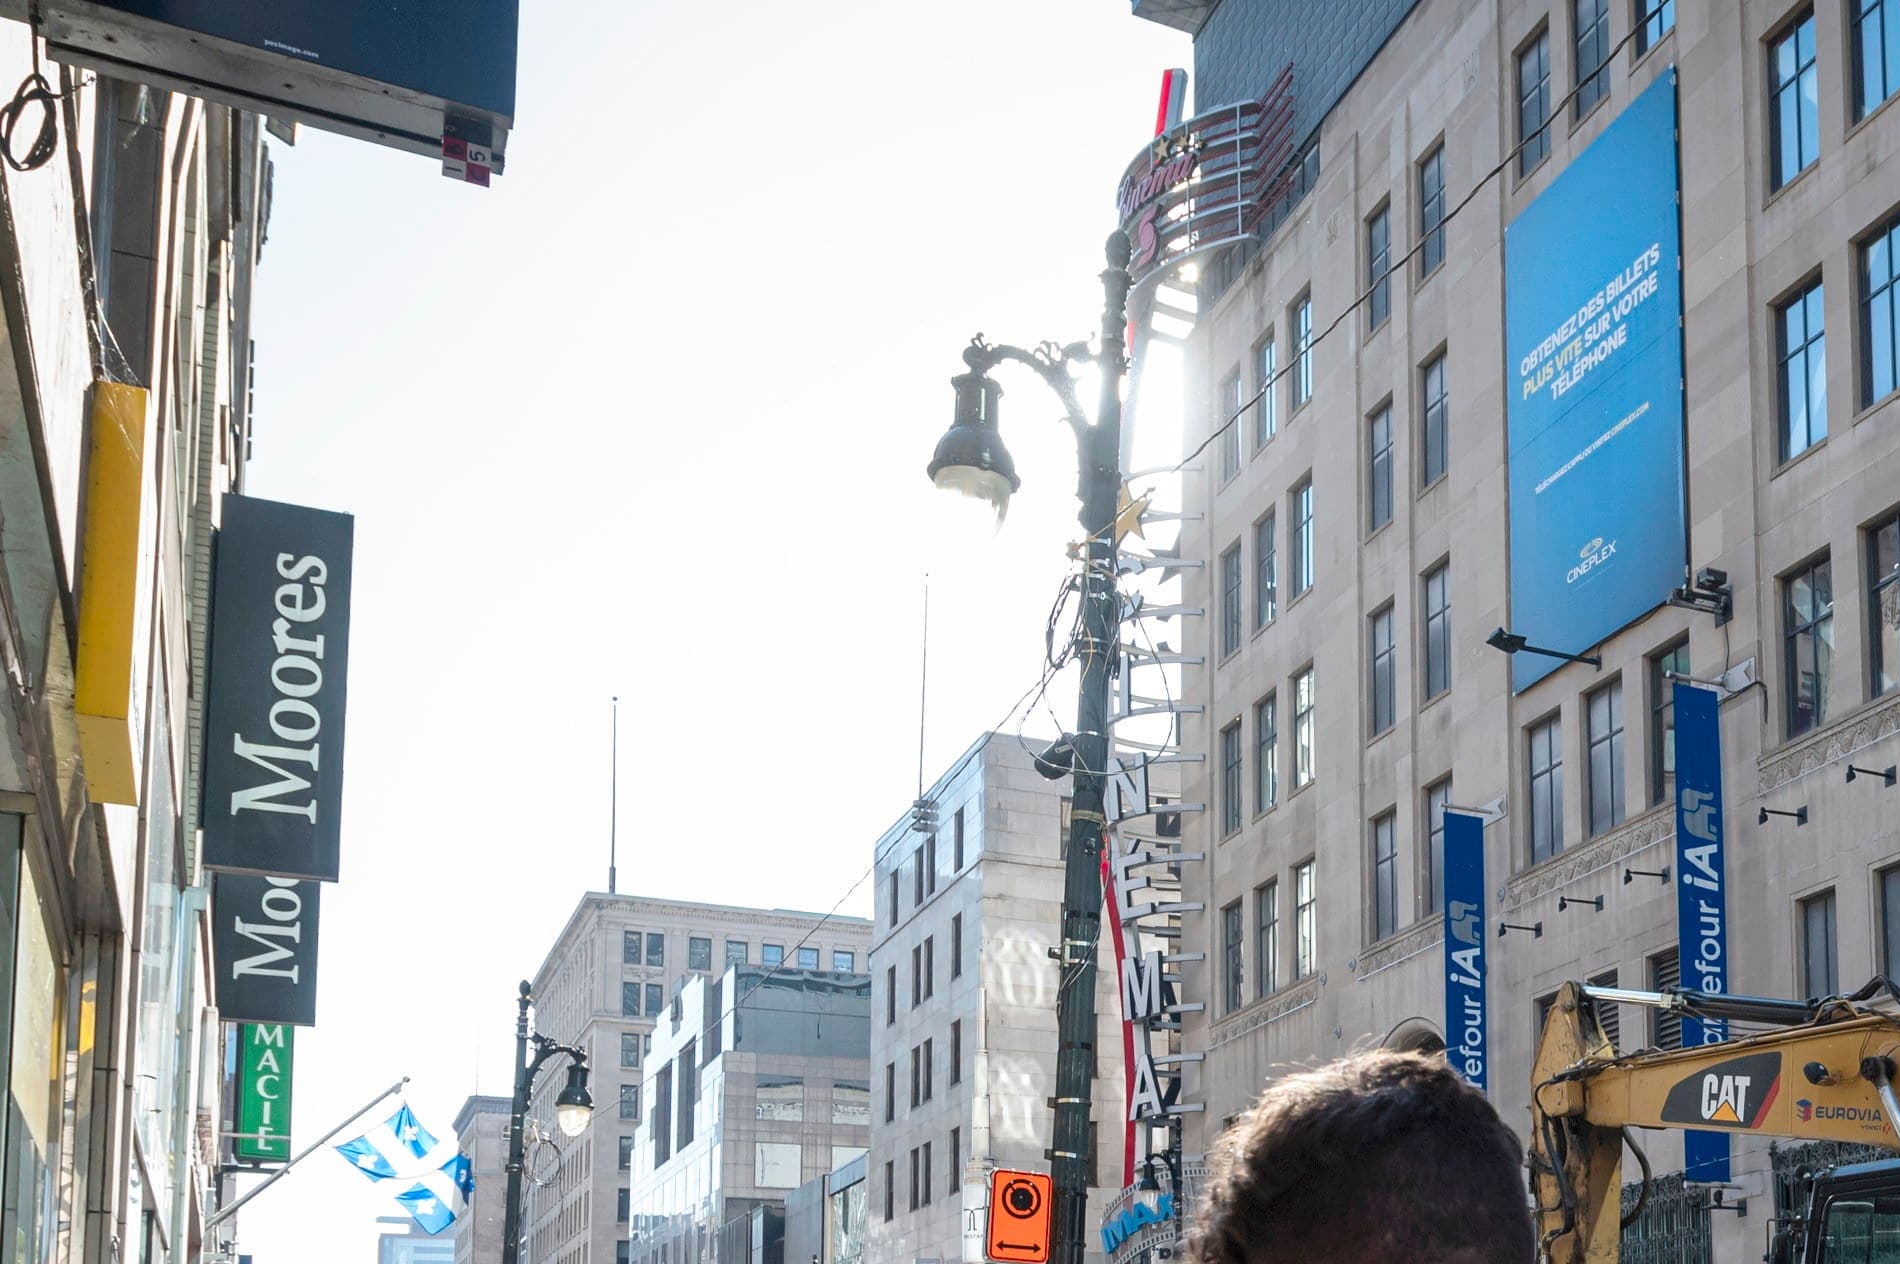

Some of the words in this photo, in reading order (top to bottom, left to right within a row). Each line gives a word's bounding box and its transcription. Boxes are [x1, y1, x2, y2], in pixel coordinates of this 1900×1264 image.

[1520, 314, 1578, 376] OBTENEZ
[1577, 290, 1605, 329] DES
[1606, 243, 1660, 304] BILLETS
[1522, 360, 1554, 400] PLUS
[1555, 335, 1583, 371] VITE
[1584, 312, 1611, 348] SUR
[1612, 270, 1658, 322] VOTRE
[1550, 322, 1627, 401] TÉLÉPHONE
[1566, 539, 1617, 584] CINEPLEX
[231, 552, 328, 824] Moores
[1701, 1073, 1750, 1123] CAT
[1815, 1106, 1882, 1121] EUROVIA
[1101, 1192, 1175, 1254] IMAX
